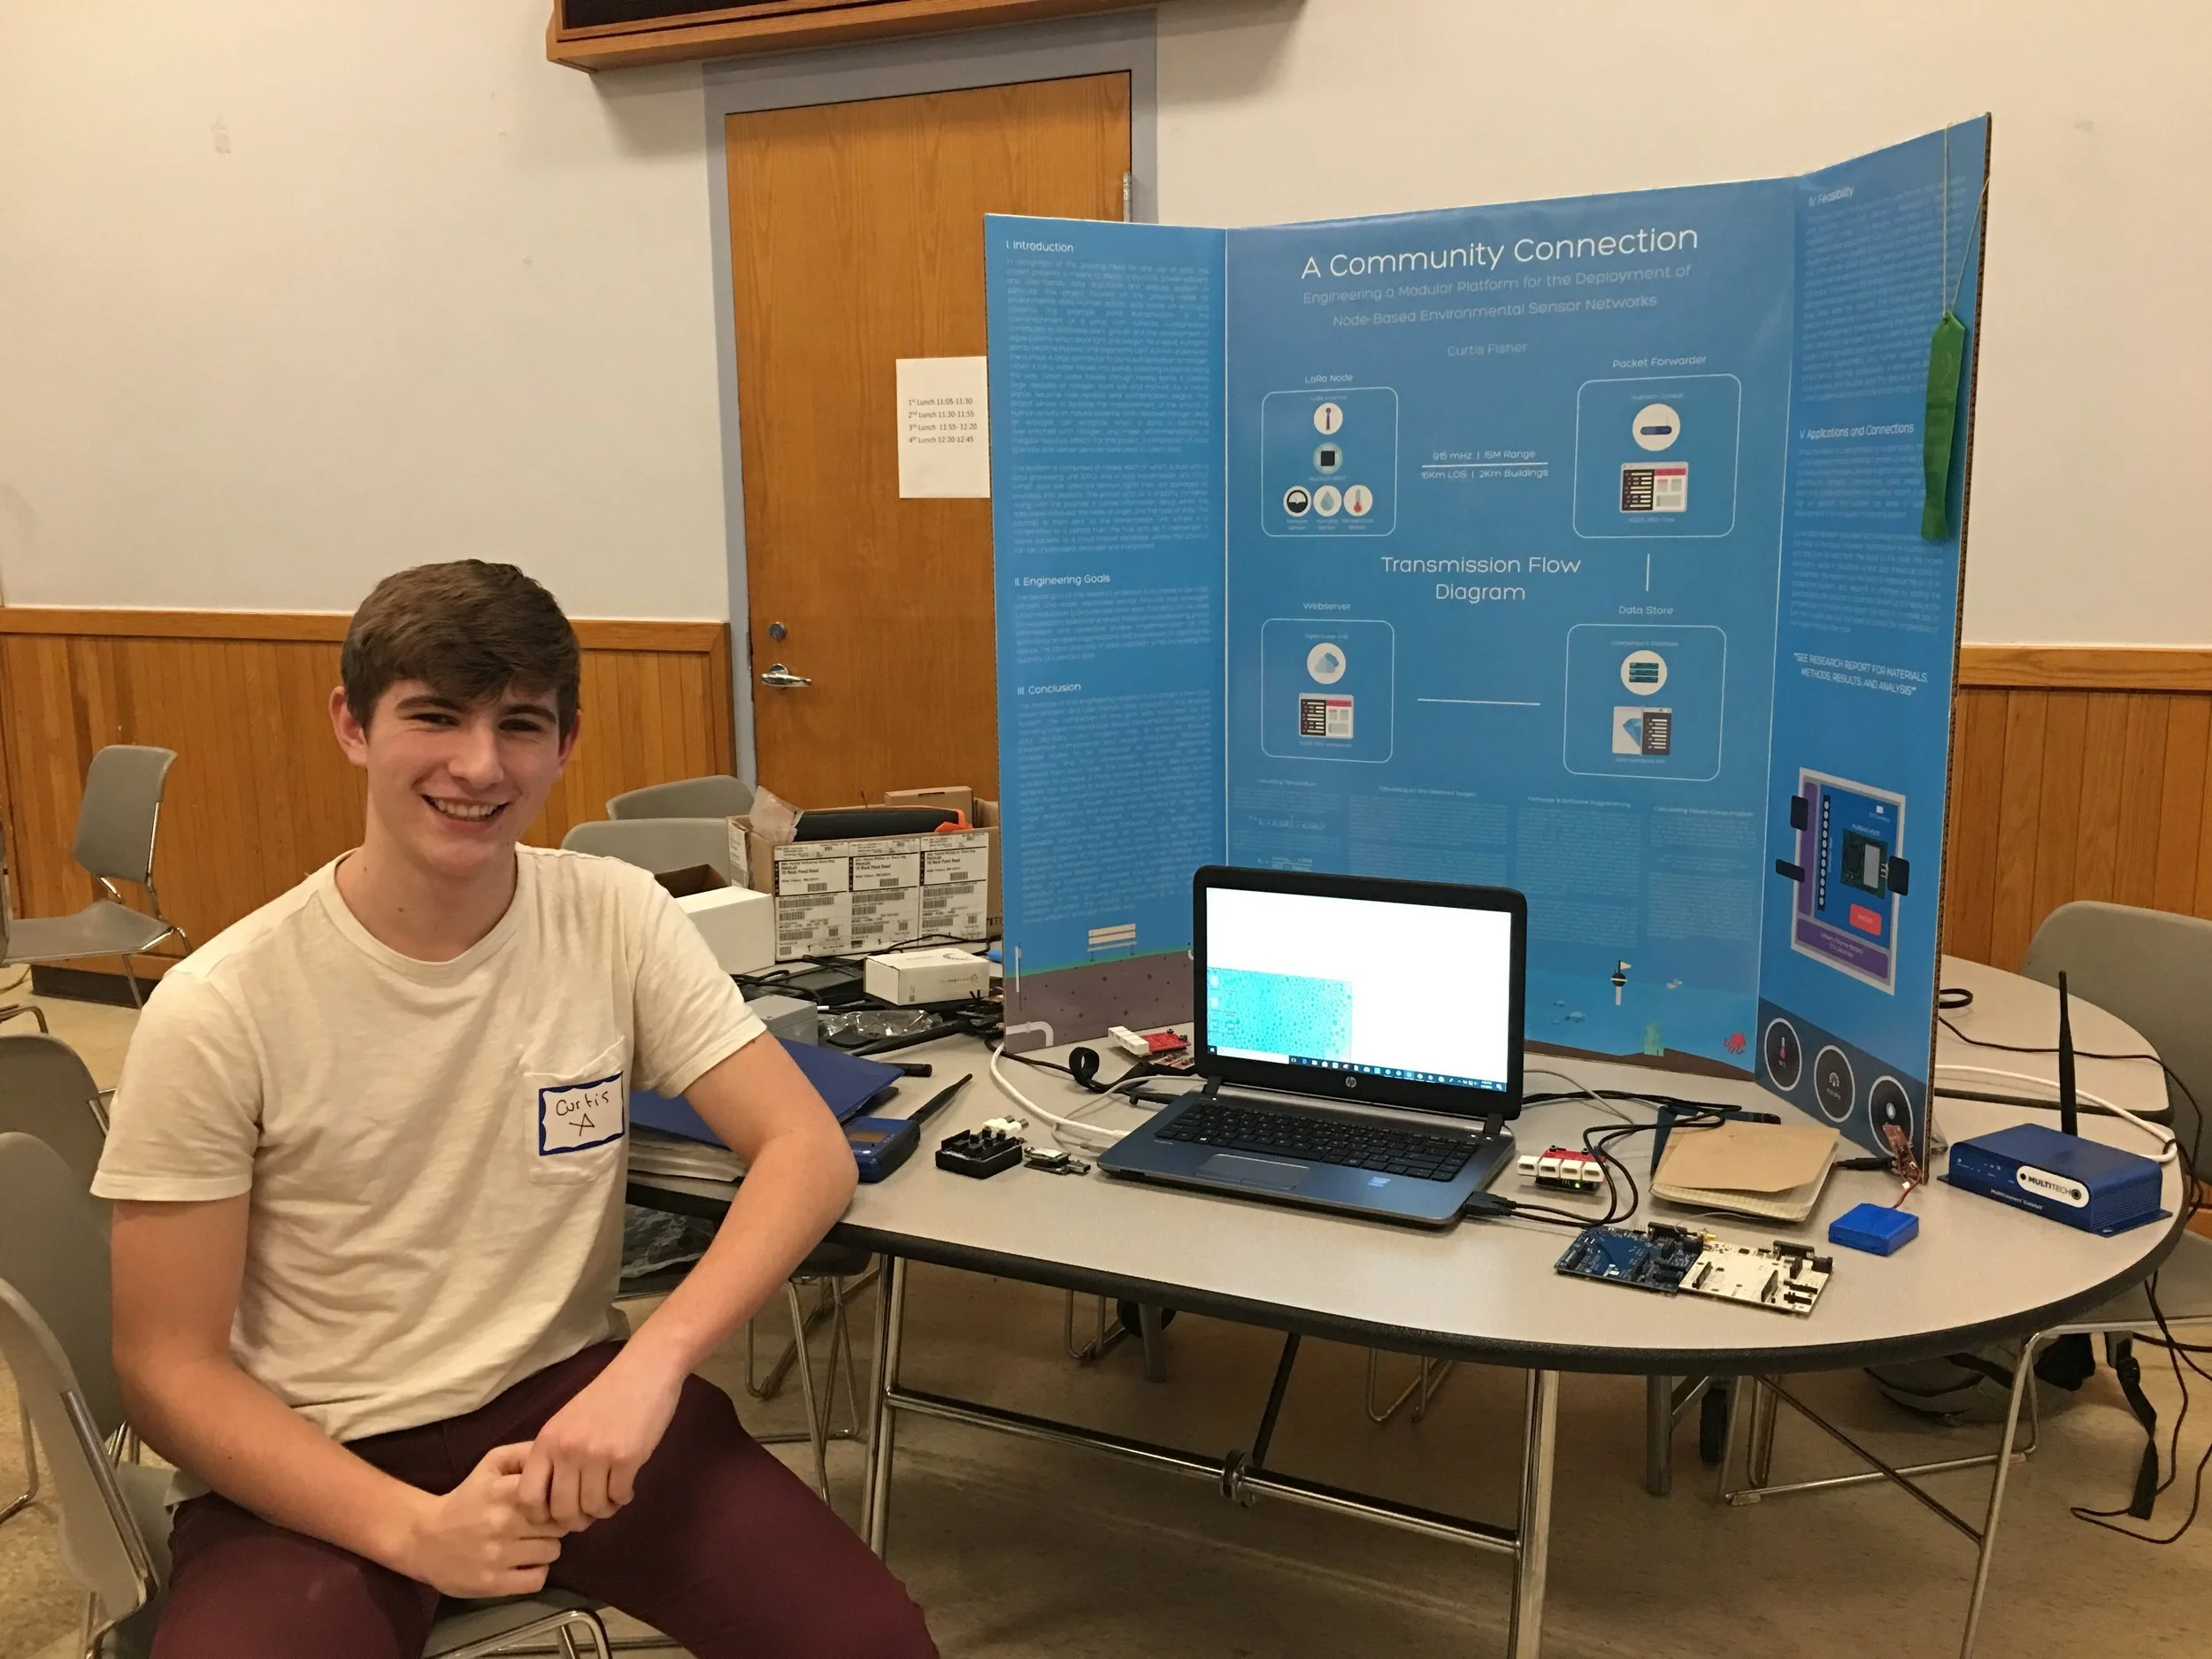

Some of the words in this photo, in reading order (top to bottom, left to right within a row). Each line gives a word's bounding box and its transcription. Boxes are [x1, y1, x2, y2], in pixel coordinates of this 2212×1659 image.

[1817, 184, 1855, 205] Feasibility
[1012, 240, 1074, 254] Introduction
[1302, 257, 1321, 280] A
[1329, 242, 1504, 279] Community
[1514, 227, 1698, 263] Connection
[1302, 287, 1382, 306] Engineering
[1386, 288, 1394, 298] a
[1398, 280, 1454, 298] Modular
[1456, 275, 1519, 293] Platform
[1523, 273, 1542, 289] for
[1547, 272, 1571, 288] the
[1575, 264, 1672, 288] Deployment
[1675, 264, 1692, 279] of
[1333, 311, 1416, 328] Node-Based
[1420, 303, 1525, 322] Environmental
[1528, 299, 1580, 315] Sensor
[1586, 294, 1657, 311] Networks
[1447, 342, 1486, 357] Curtis
[1487, 341, 1529, 355] Fisher
[1612, 357, 1648, 370] Packet
[1650, 355, 1707, 367] Forwarder
[1305, 374, 1328, 384] LoRa
[1330, 373, 1354, 382] Node
[1807, 427, 1849, 441] Applications
[1850, 426, 1865, 436] and
[1865, 424, 1915, 436] Connections
[1449, 451, 1472, 460] mHz
[1484, 450, 1502, 459] ISM
[1503, 449, 1536, 461] Range
[1448, 470, 1467, 479] LOS
[1479, 469, 1502, 479] 2Km
[1504, 468, 1549, 480] Buildings
[1380, 556, 1521, 573] Transmission
[1528, 556, 1582, 573] Flow
[1023, 576, 1082, 588] Engineering
[1084, 573, 1111, 584] Goals
[1435, 583, 1525, 604] Diagram
[1302, 601, 1352, 611] Webserver
[1618, 605, 1644, 615] Data
[1646, 605, 1674, 615] Store
[1809, 654, 1844, 669] RESEARCH
[1844, 659, 1871, 673] REPORT
[1871, 664, 1886, 676] FOR
[1028, 683, 1082, 695] Conclusion
[1863, 678, 1878, 689] AND
[556, 1091, 610, 1117] Curtis
[2028, 1175, 2072, 1196] MULTITECH
